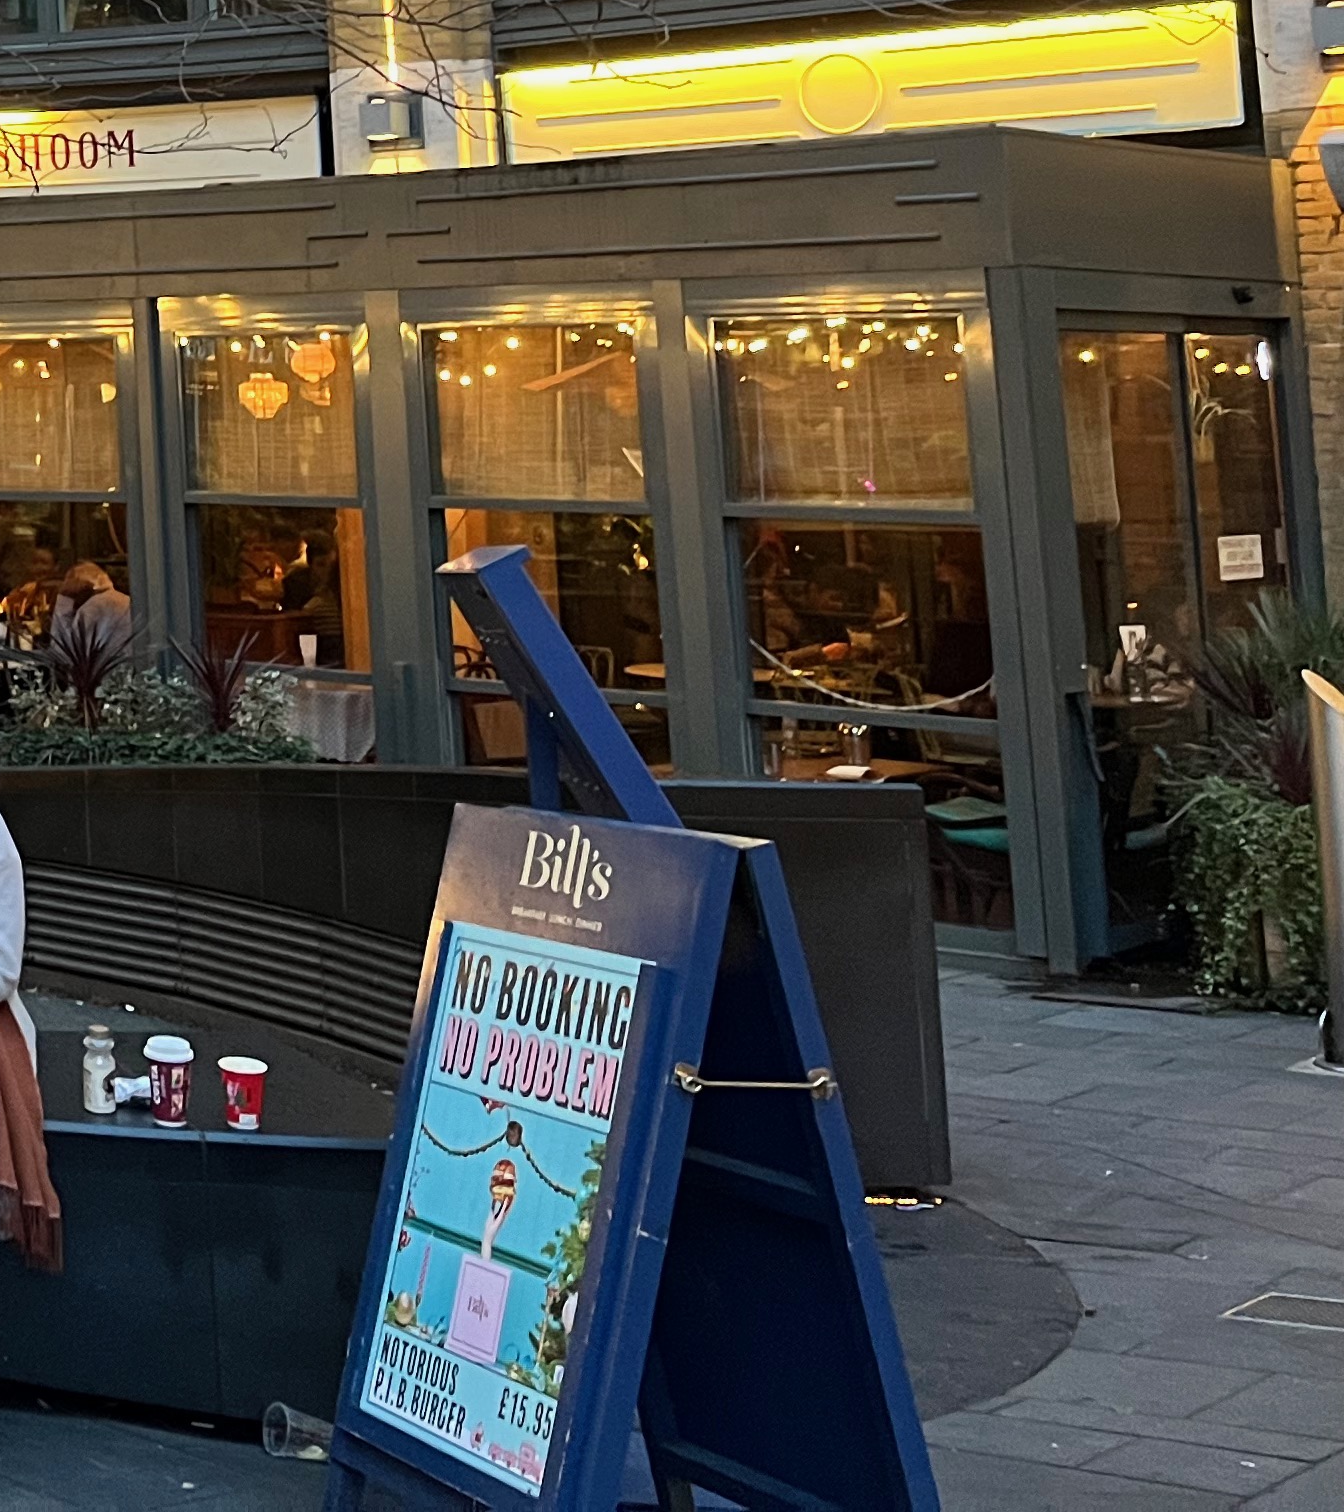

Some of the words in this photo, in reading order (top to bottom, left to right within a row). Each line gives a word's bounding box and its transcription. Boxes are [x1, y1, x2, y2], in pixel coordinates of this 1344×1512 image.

[519, 824, 612, 908] Bill's
[452, 951, 492, 1014] NO
[496, 961, 631, 1050] BOOKING
[440, 1013, 479, 1079] NO
[481, 1024, 619, 1120] PROBLEM
[379, 1332, 460, 1396] NOTORIOUS
[411, 1385, 466, 1439] BURGER
[498, 1386, 554, 1440] £15.95
